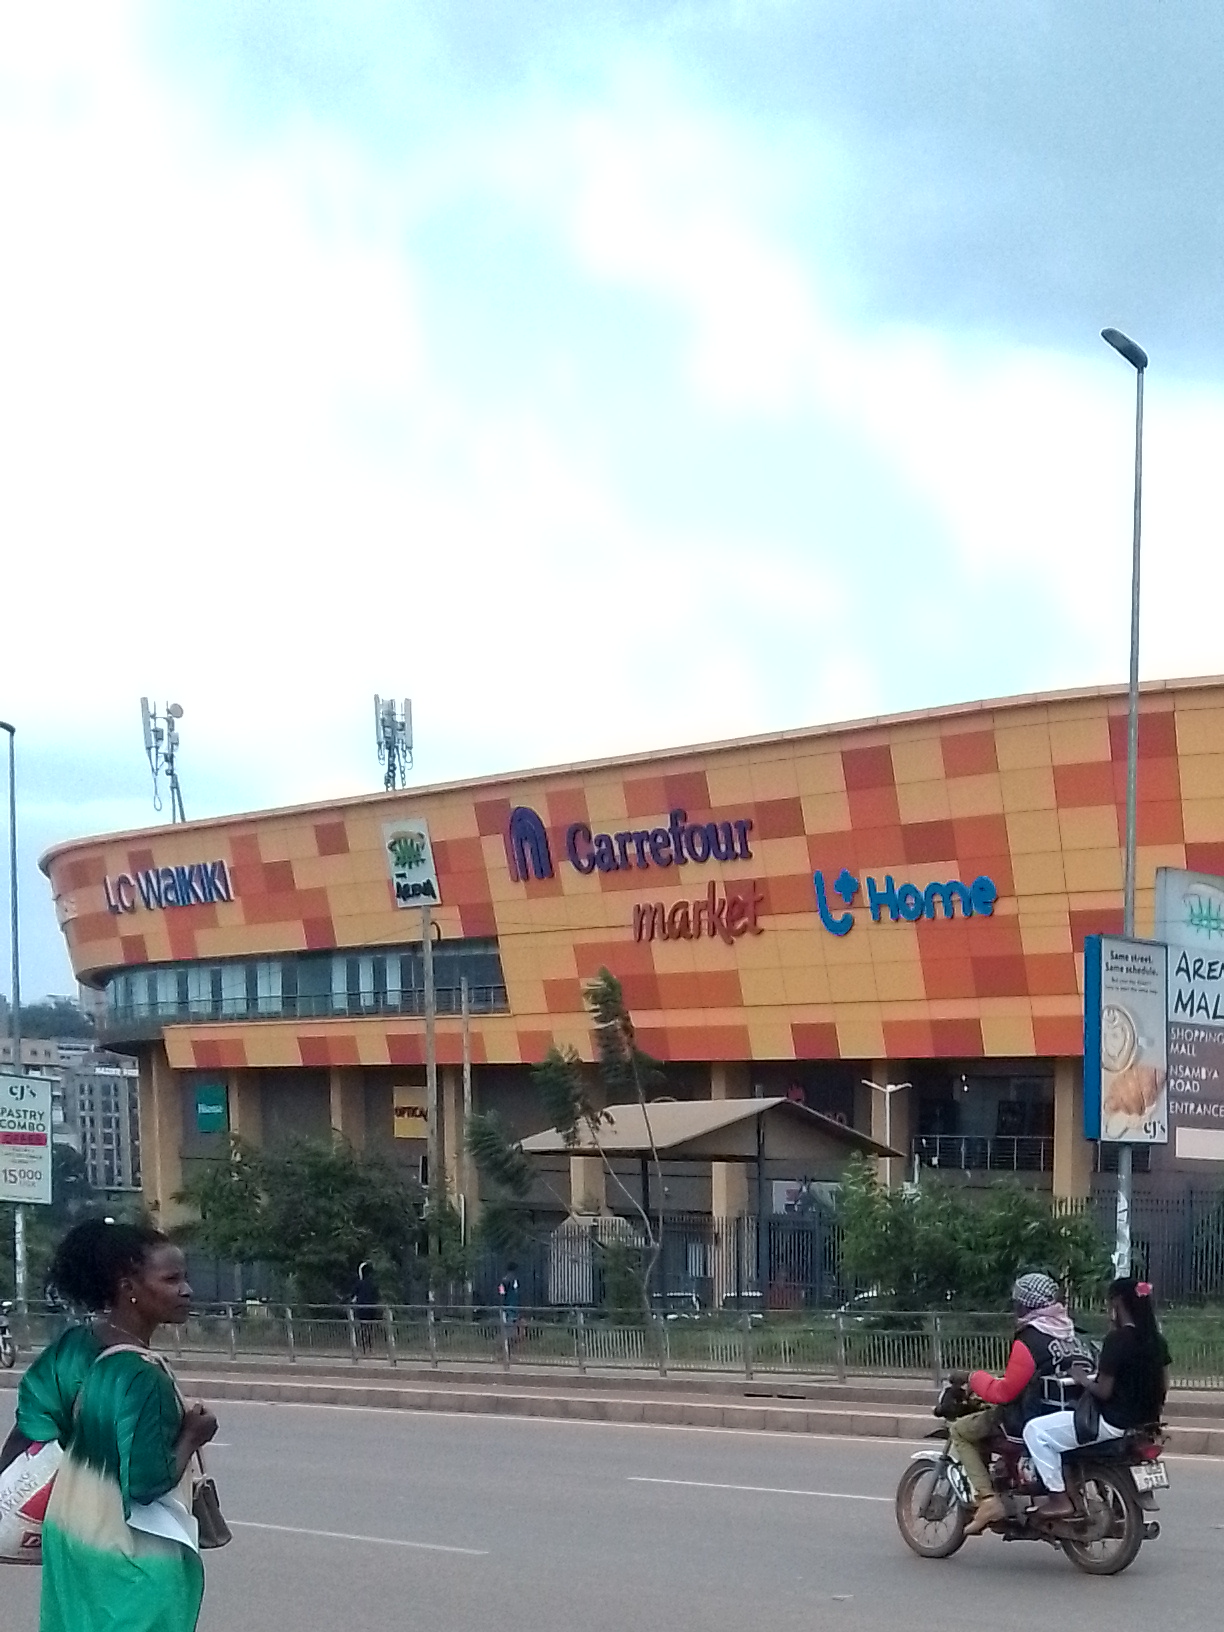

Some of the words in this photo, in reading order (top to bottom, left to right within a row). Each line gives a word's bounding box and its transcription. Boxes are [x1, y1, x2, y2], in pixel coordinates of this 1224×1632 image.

[566, 808, 753, 874] Carrefour
[104, 873, 136, 914] LC
[867, 874, 997, 922] Home
[633, 880, 765, 945] market
[1170, 1042, 1197, 1057] MALL
[1169, 1064, 1220, 1081] NSAMBYA
[1169, 1078, 1201, 1094] ROAD
[0, 1106, 45, 1121] PASTRY
[0, 1118, 46, 1133] COMBO
